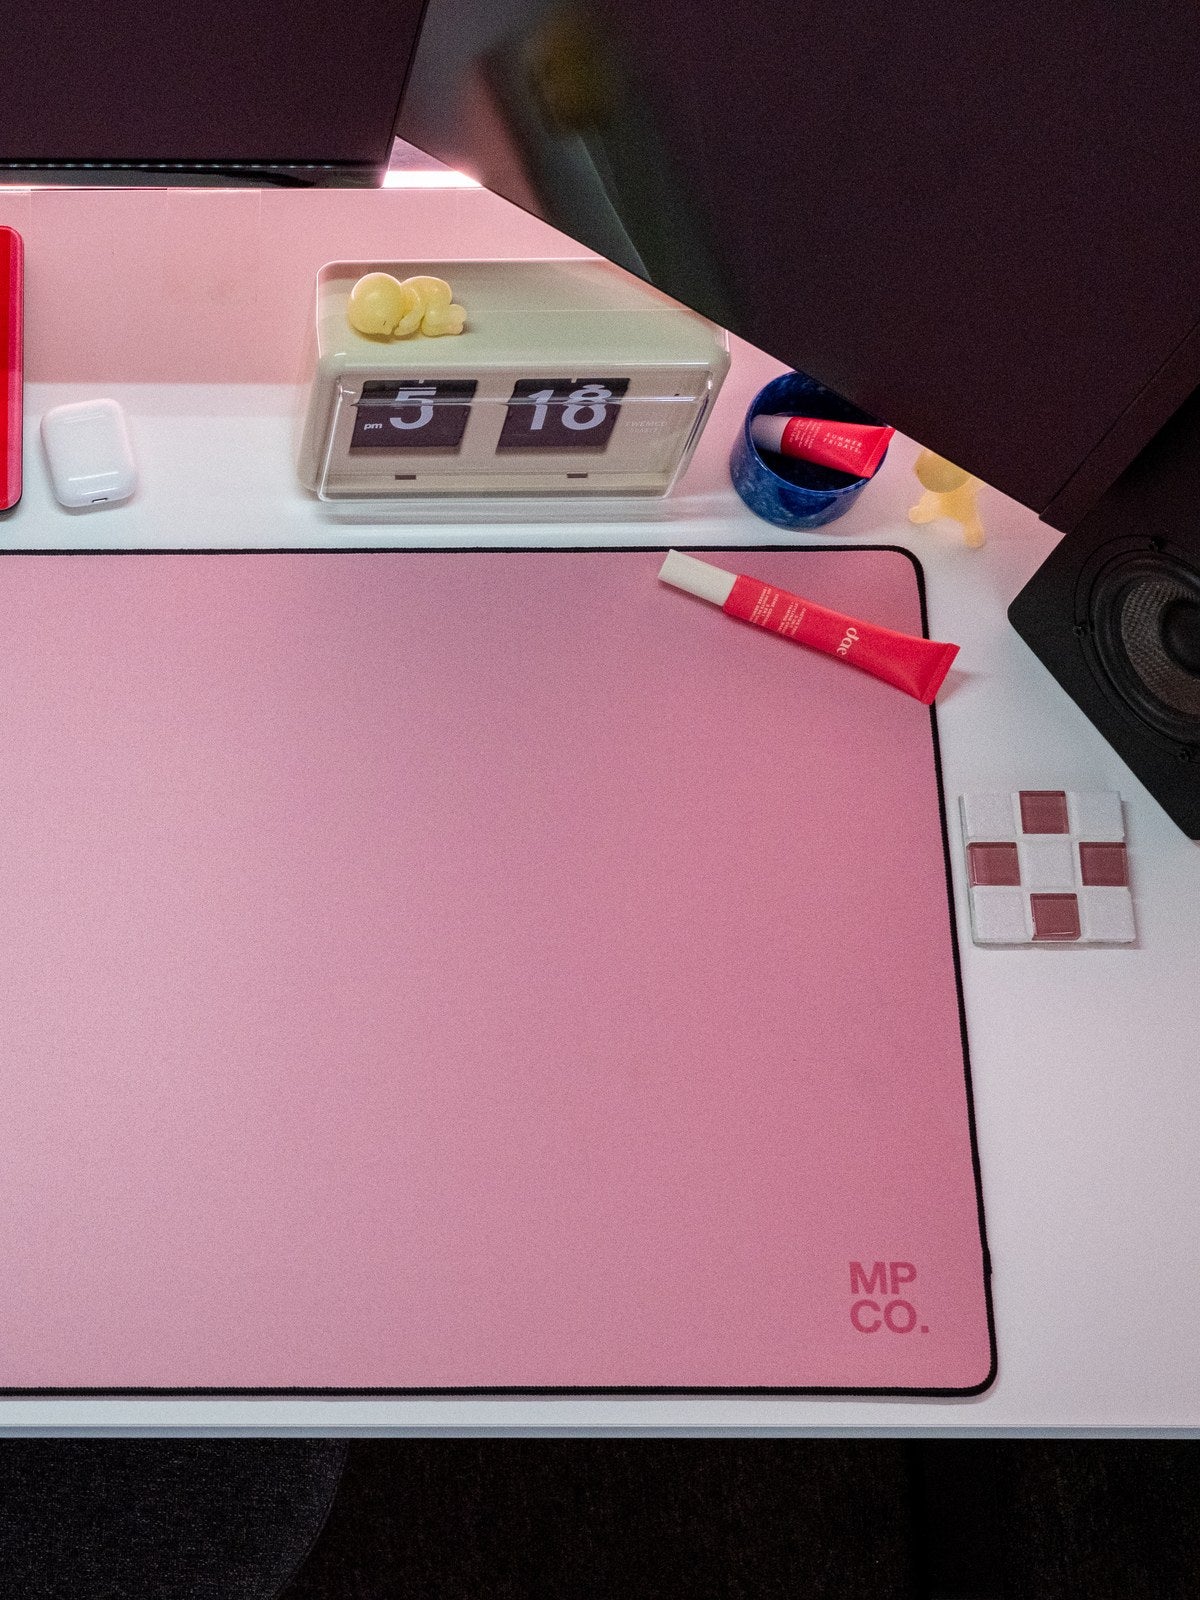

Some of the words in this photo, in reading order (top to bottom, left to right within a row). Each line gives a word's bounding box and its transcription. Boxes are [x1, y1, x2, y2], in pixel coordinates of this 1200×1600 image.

[364, 422, 382, 431] pm
[390, 386, 437, 430] 5
[527, 384, 613, 431] 18
[826, 432, 863, 447] SUMMER
[837, 627, 859, 655] dae
[849, 1262, 917, 1294] MP
[850, 1300, 929, 1334] CO.
